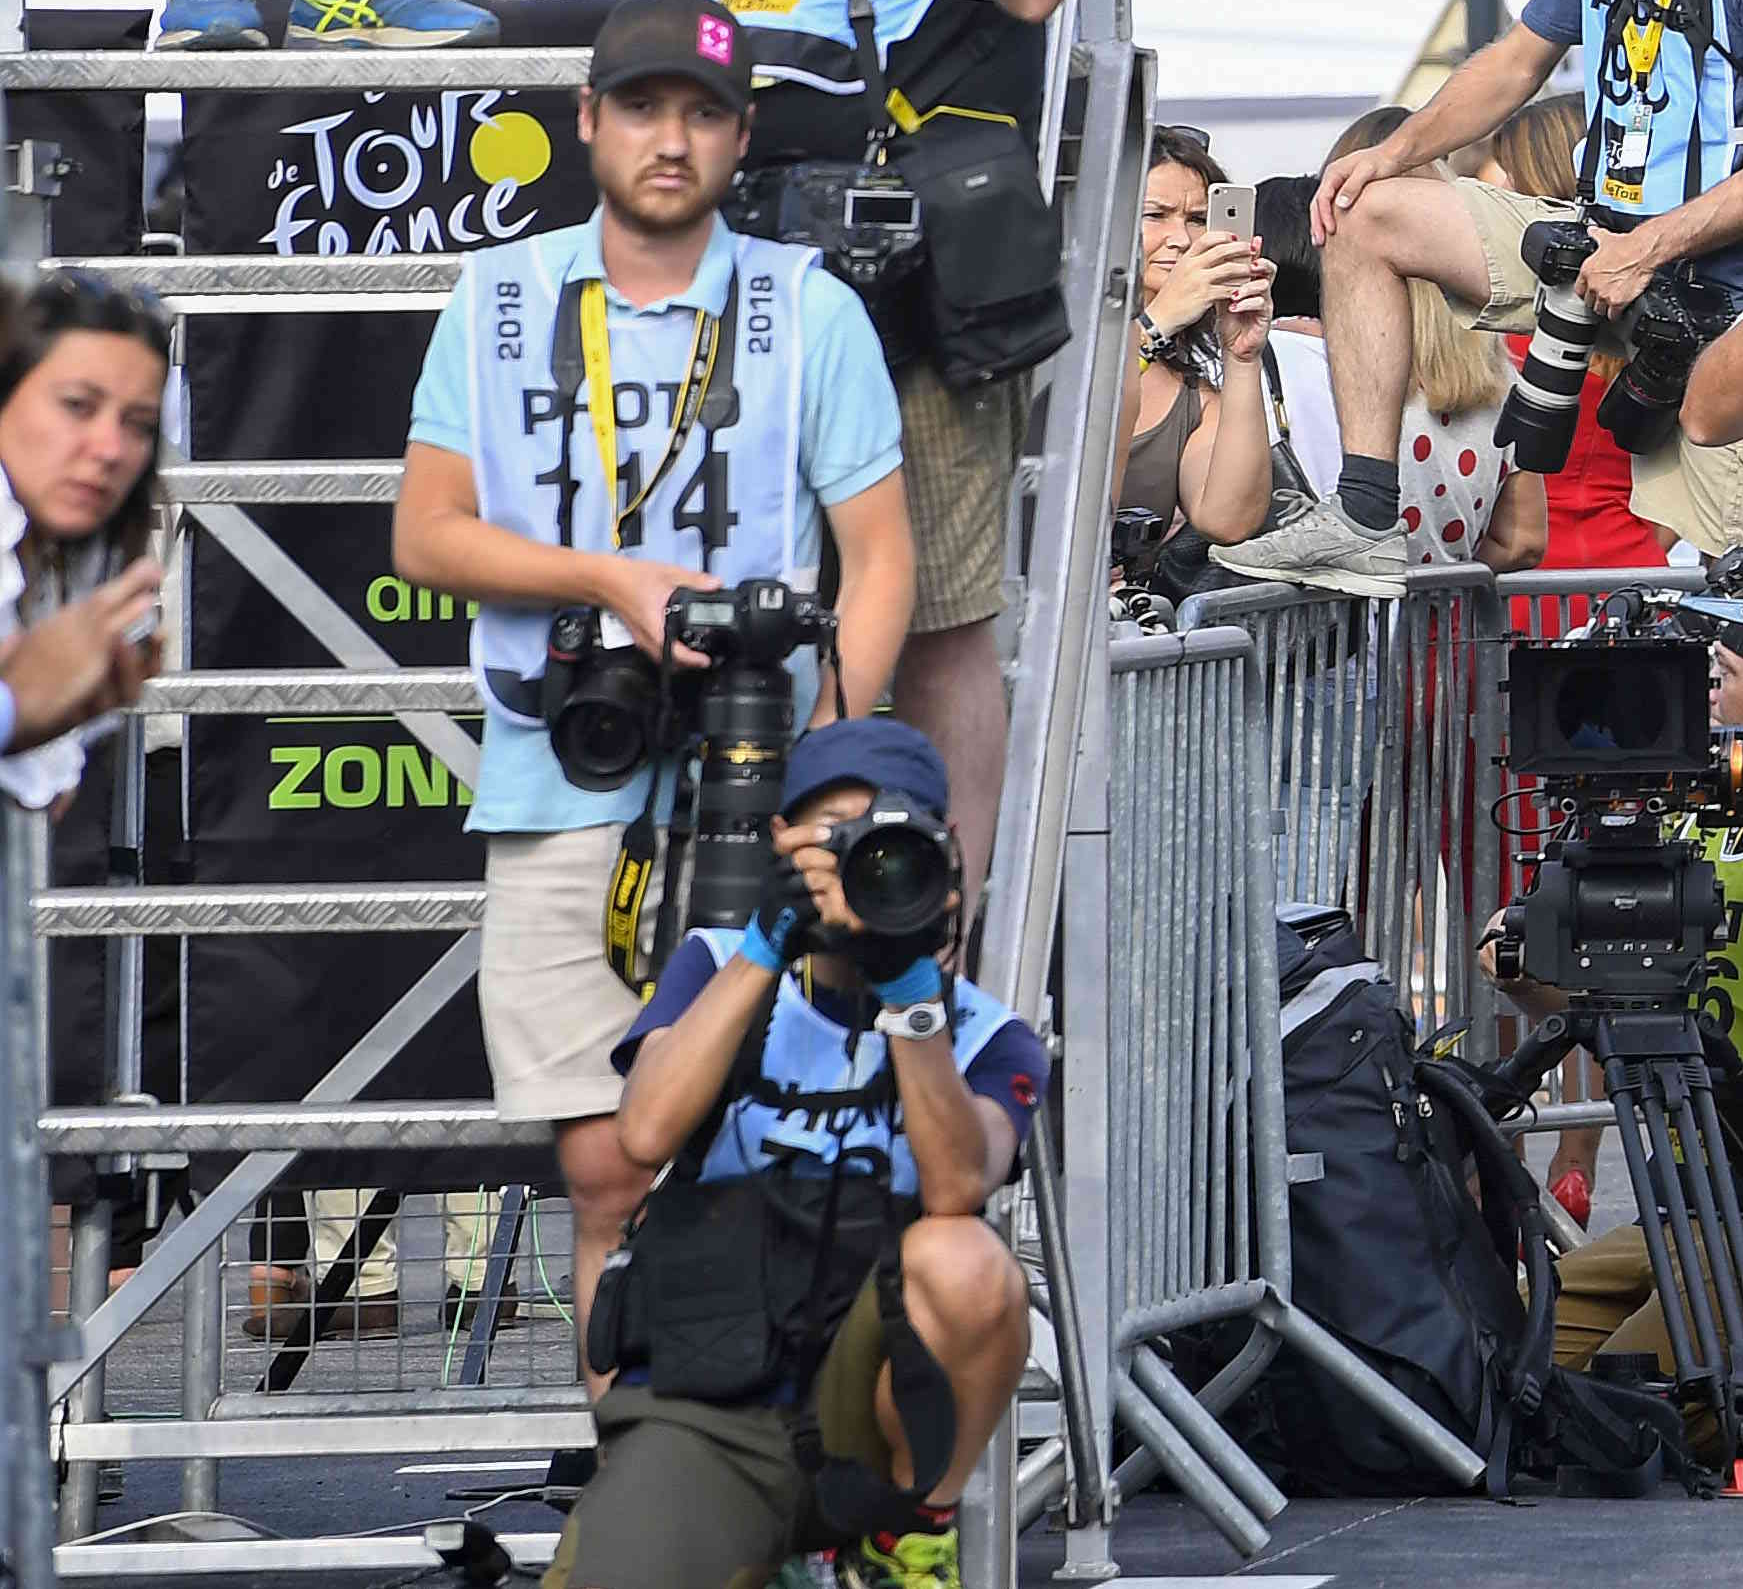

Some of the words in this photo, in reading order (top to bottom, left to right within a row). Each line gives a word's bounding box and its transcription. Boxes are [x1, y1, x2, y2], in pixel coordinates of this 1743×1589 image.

[266, 159, 300, 190] de
[497, 281, 523, 361] 2018
[748, 274, 773, 354] 2018
[534, 450, 739, 548] 114
